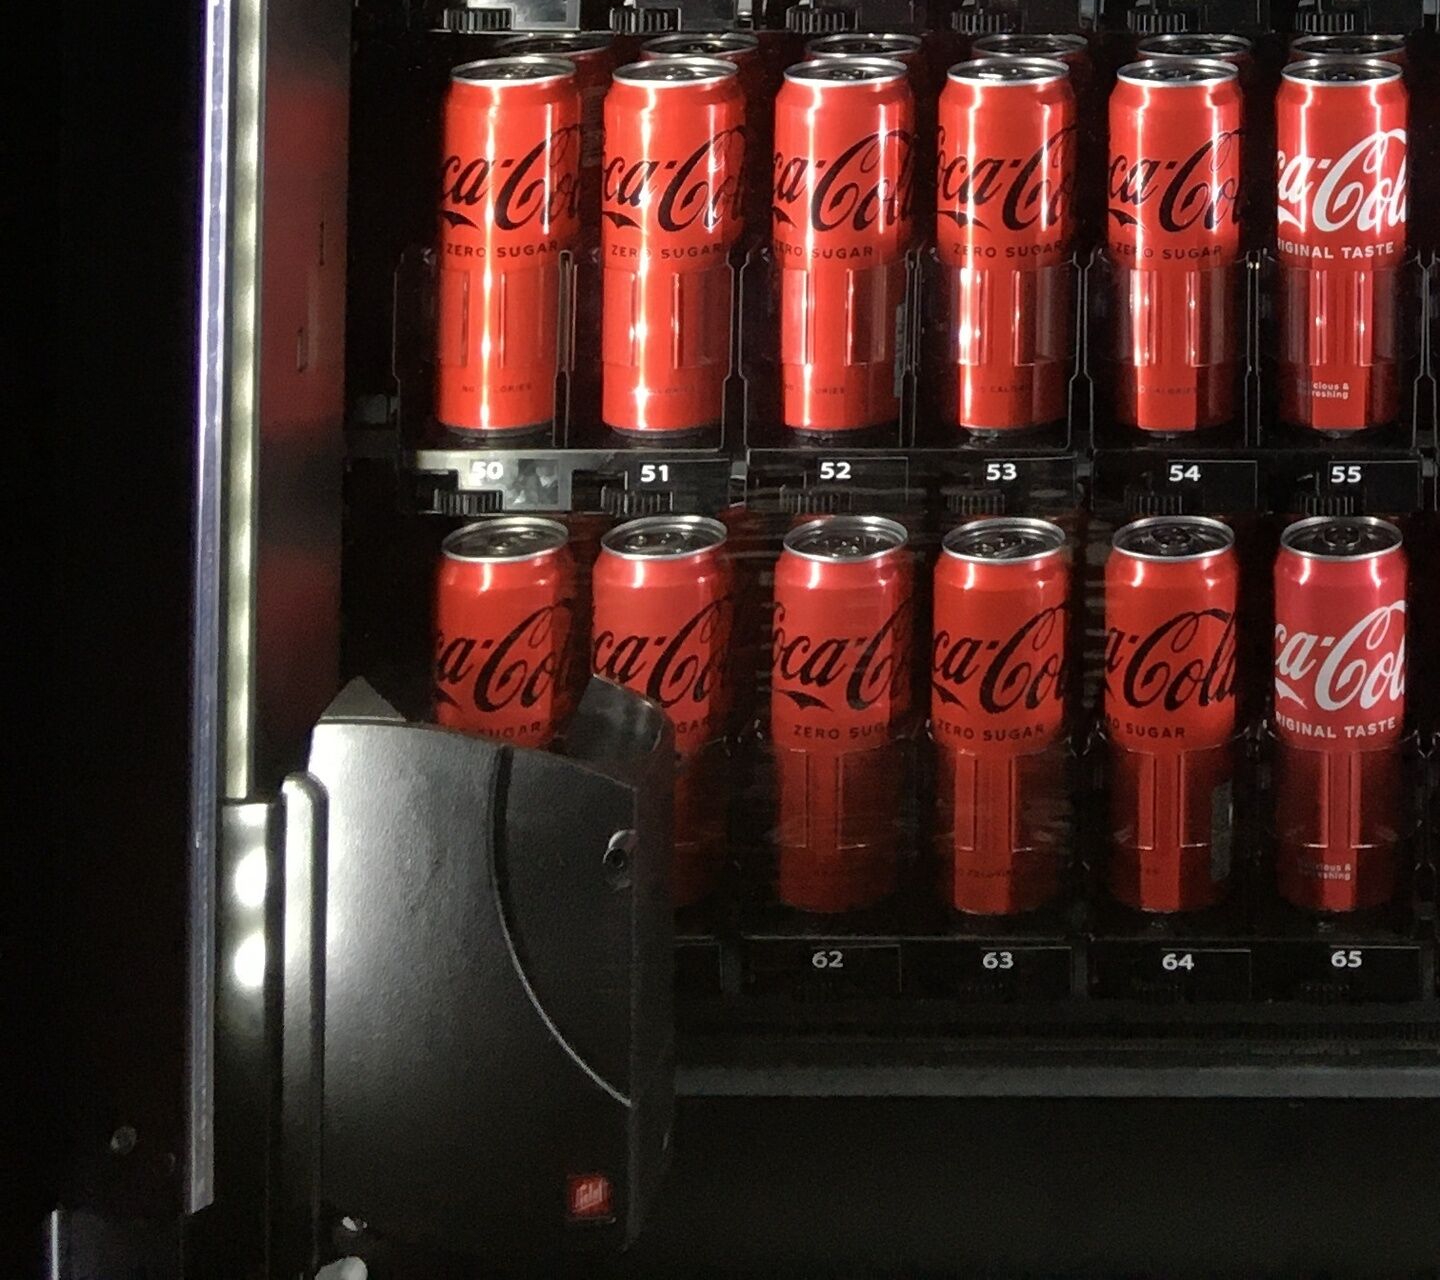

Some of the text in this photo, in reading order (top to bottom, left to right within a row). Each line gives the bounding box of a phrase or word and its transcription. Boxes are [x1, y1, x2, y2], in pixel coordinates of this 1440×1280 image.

[446, 242, 558, 258] ZERO SUGAR
[660, 243, 724, 260] SUGAR
[811, 245, 873, 260] SUGAR
[1162, 244, 1223, 260] SUGAR
[1341, 241, 1395, 259] TASTE
[471, 462, 503, 480] 50
[640, 464, 669, 483] 51
[820, 461, 851, 480] 52
[986, 463, 1017, 481] 53
[1169, 464, 1201, 482] 54
[1331, 466, 1362, 483] 55
[794, 724, 840, 740] ZERO
[937, 719, 1045, 742] ZERO SUGAR
[1125, 722, 1186, 739] SUGAR
[1344, 716, 1396, 738] TASTE
[811, 950, 844, 968] 62
[982, 951, 1014, 969] 63
[1162, 953, 1195, 970] 64
[1331, 950, 1362, 968] 65
